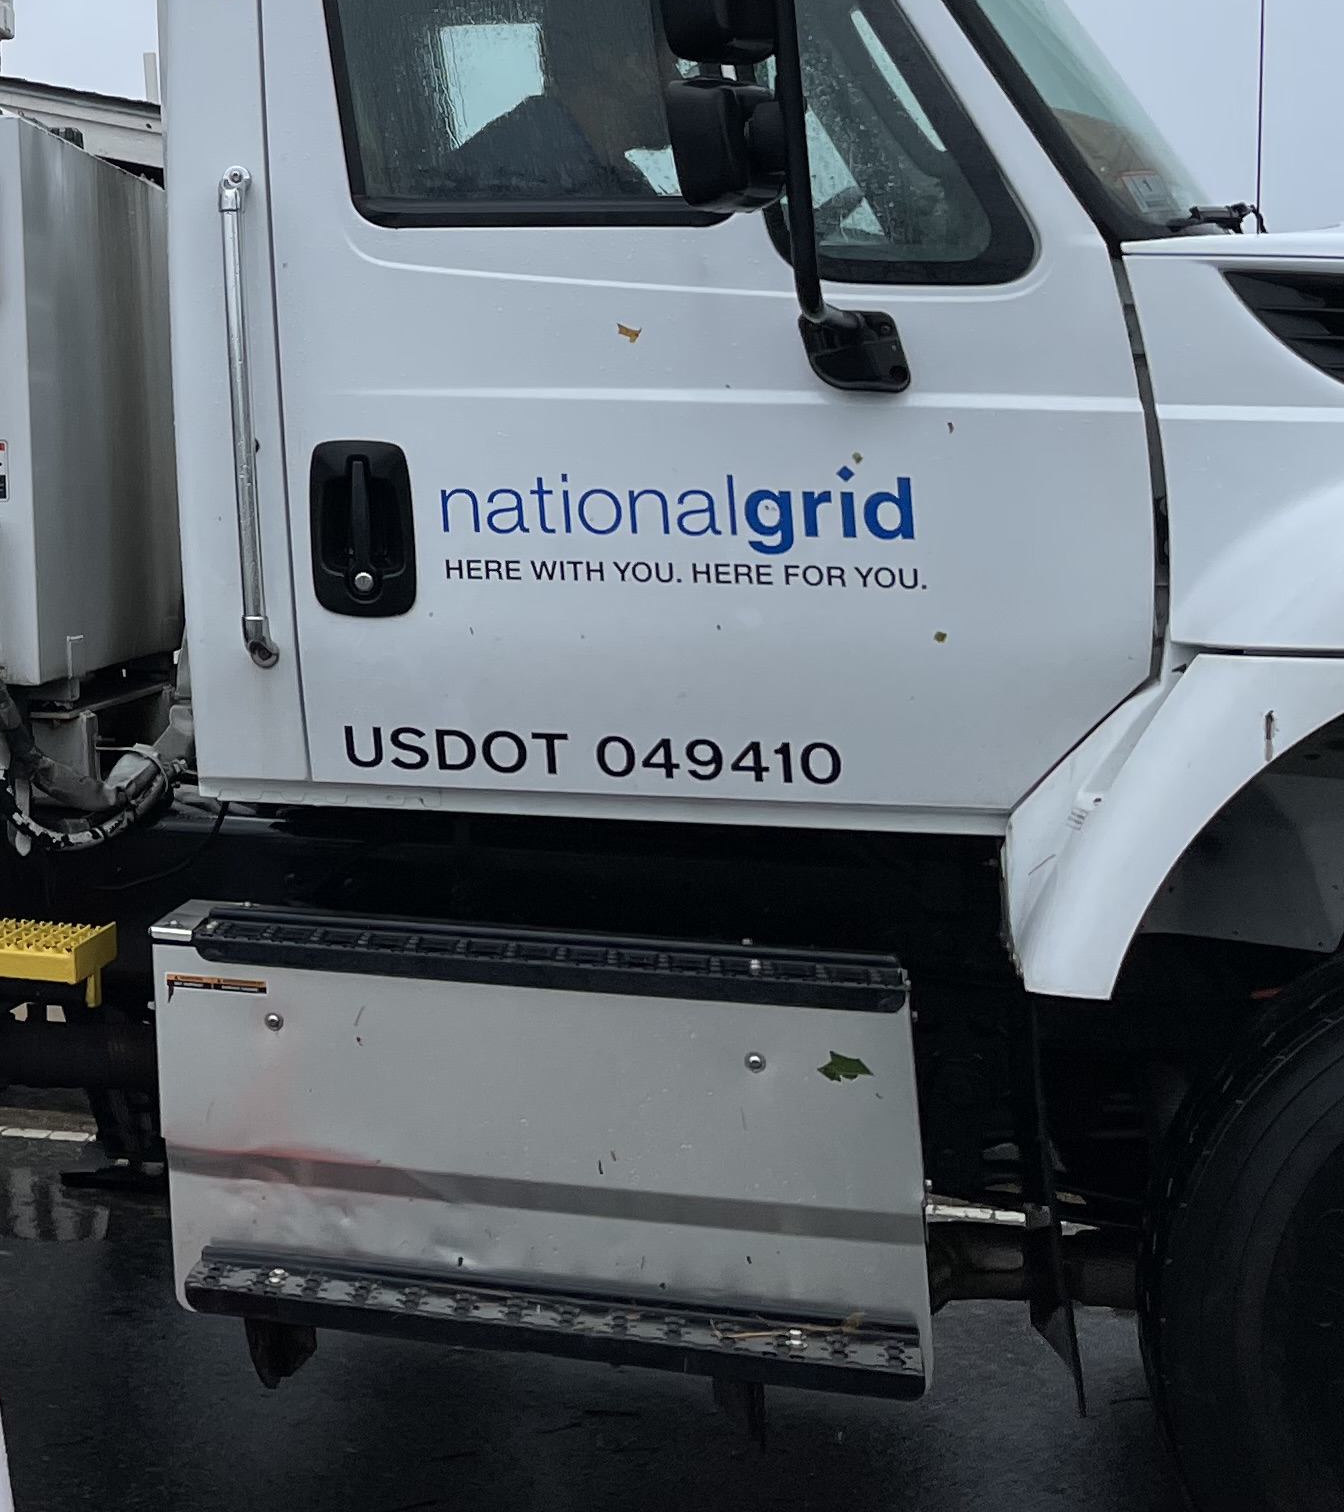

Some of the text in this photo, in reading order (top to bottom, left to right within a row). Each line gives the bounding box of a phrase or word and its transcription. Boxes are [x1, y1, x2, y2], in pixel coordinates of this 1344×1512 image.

[439, 465, 916, 555] nationalgrid
[444, 559, 927, 590] HERE WITH YOU. HERE FOR YOU.
[343, 725, 841, 785] USDOT 049410
